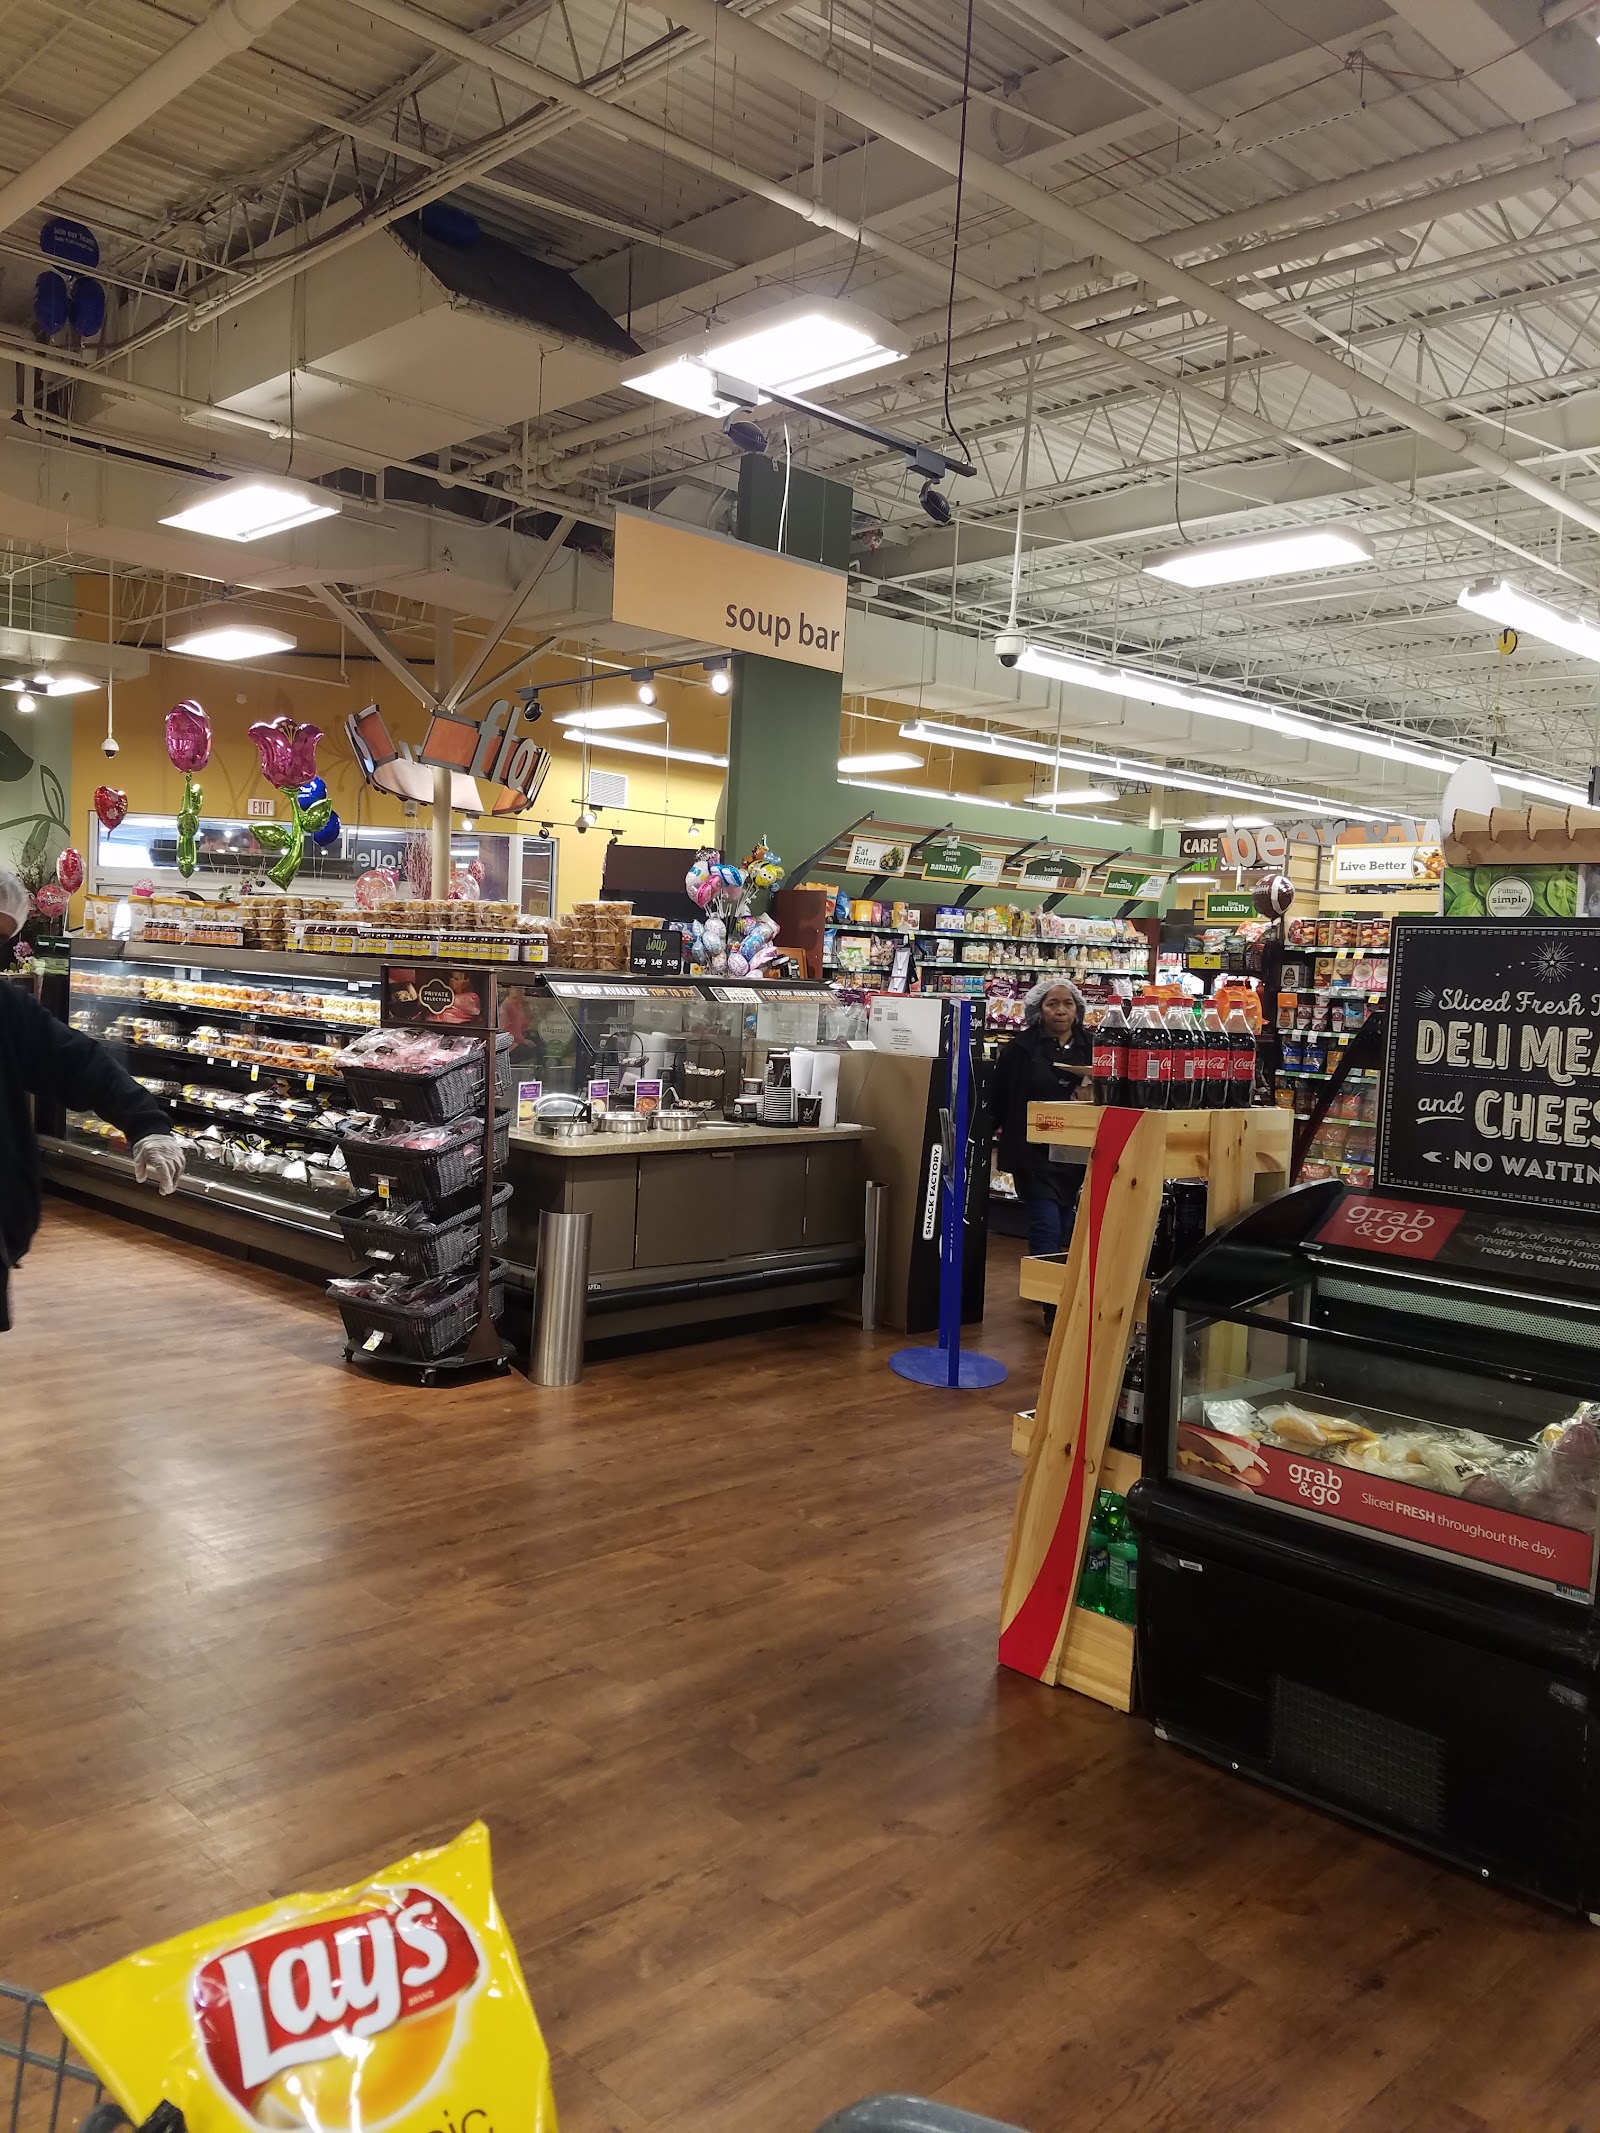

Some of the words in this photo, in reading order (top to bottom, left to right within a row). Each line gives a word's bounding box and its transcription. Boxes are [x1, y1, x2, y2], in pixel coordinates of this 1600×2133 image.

[725, 603, 791, 647] soup
[798, 611, 840, 652] bar
[252, 801, 270, 814] EXIT
[855, 845, 869, 856] Eat
[942, 849, 961, 858] gluten
[1183, 838, 1219, 854] CARE
[853, 855, 877, 867] Better
[929, 862, 963, 875] naturally
[1339, 861, 1366, 871] Live
[1369, 861, 1407, 871] Better
[1043, 865, 1064, 875] baking
[1107, 881, 1134, 892] naturally
[1497, 887, 1524, 896] Putting
[1491, 895, 1528, 906] simple
[1211, 905, 1250, 914] naturally
[652, 932, 662, 940] hot
[645, 936, 668, 957] soup
[633, 957, 647, 965] 2.99
[650, 958, 663, 966] 3.49
[666, 959, 679, 967] 5.99
[424, 990, 449, 998] PRIVATE
[556, 984, 578, 995] HOT
[579, 984, 602, 995] SOUP
[604, 986, 650, 997] AVAILABLE
[669, 988, 680, 997] TO
[1438, 988, 1511, 1012] Sliced
[1515, 991, 1586, 1016] Fresh
[1416, 1019, 1512, 1070] DELI
[1417, 1091, 1465, 1114] and
[1453, 1150, 1493, 1173] NO
[929, 1148, 940, 1197] FACTORY
[925, 1200, 935, 1236] SNACK
[1345, 1205, 1436, 1229] grab
[1354, 1221, 1423, 1245] &go
[1474, 1233, 1516, 1247] Private
[1493, 1226, 1528, 1240] Many
[1528, 1232, 1545, 1241] of
[1541, 1235, 1573, 1246] your
[1480, 1246, 1519, 1259] ready
[1519, 1251, 1535, 1260] to
[1536, 1254, 1567, 1266] take
[1288, 1462, 1343, 1491] grab
[1298, 1481, 1341, 1506] &go
[1361, 1492, 1395, 1513] Sliced
[1395, 1502, 1436, 1525] FRESH
[1437, 1513, 1507, 1545] throughout
[1508, 1534, 1530, 1551] the
[1531, 1540, 1558, 1560] day.
[218, 1900, 449, 2091] Lay's
